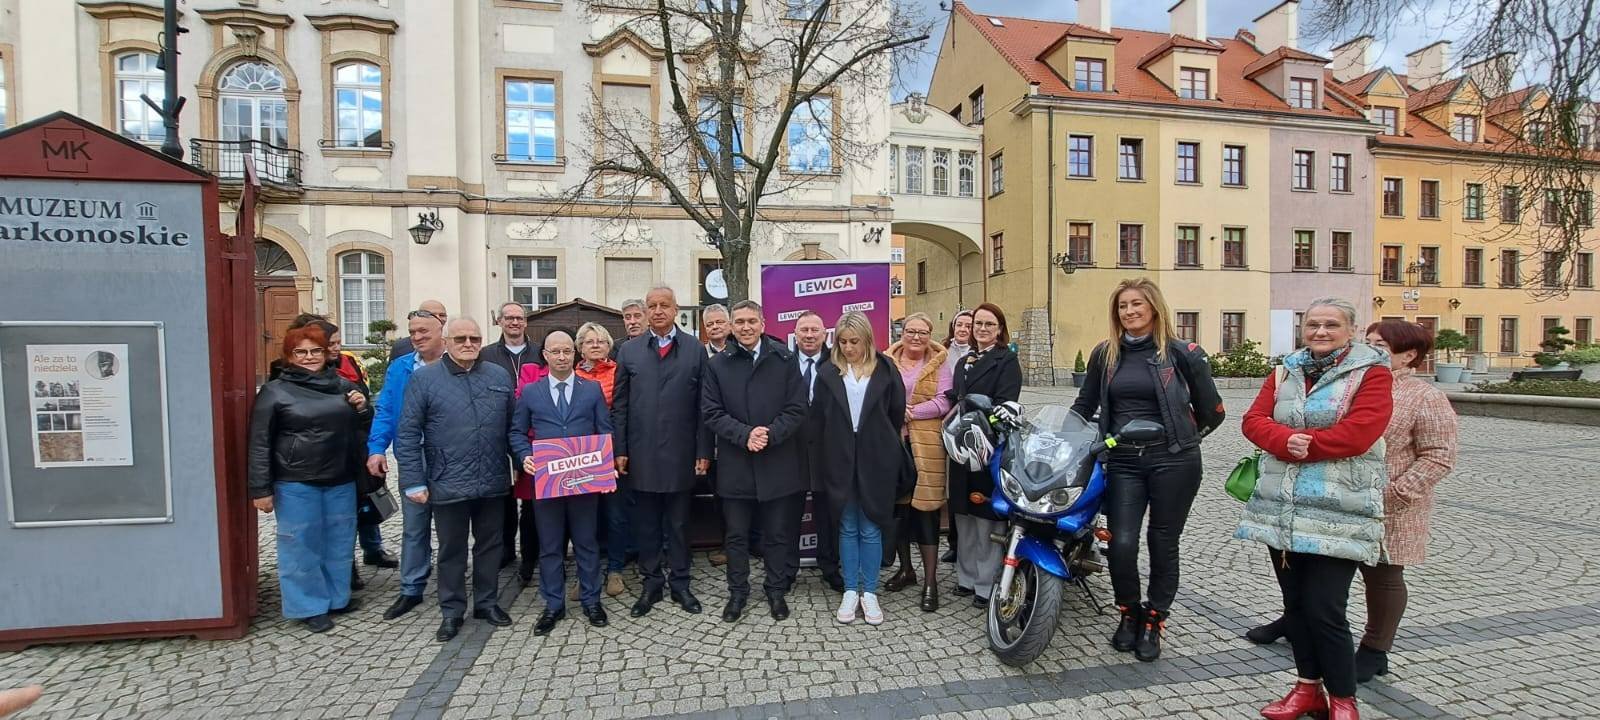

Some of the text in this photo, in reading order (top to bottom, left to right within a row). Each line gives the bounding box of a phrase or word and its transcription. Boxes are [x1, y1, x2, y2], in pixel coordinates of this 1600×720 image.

[41, 139, 93, 161] MK
[0, 196, 122, 219] MUZEUM
[798, 277, 854, 294] LEWICA
[844, 303, 873, 312] LEWICA
[779, 311, 803, 320] LEWIC
[33, 354, 51, 363] Ale
[66, 354, 77, 362] to
[34, 364, 78, 373] niedziela
[551, 454, 600, 472] LEWICA
